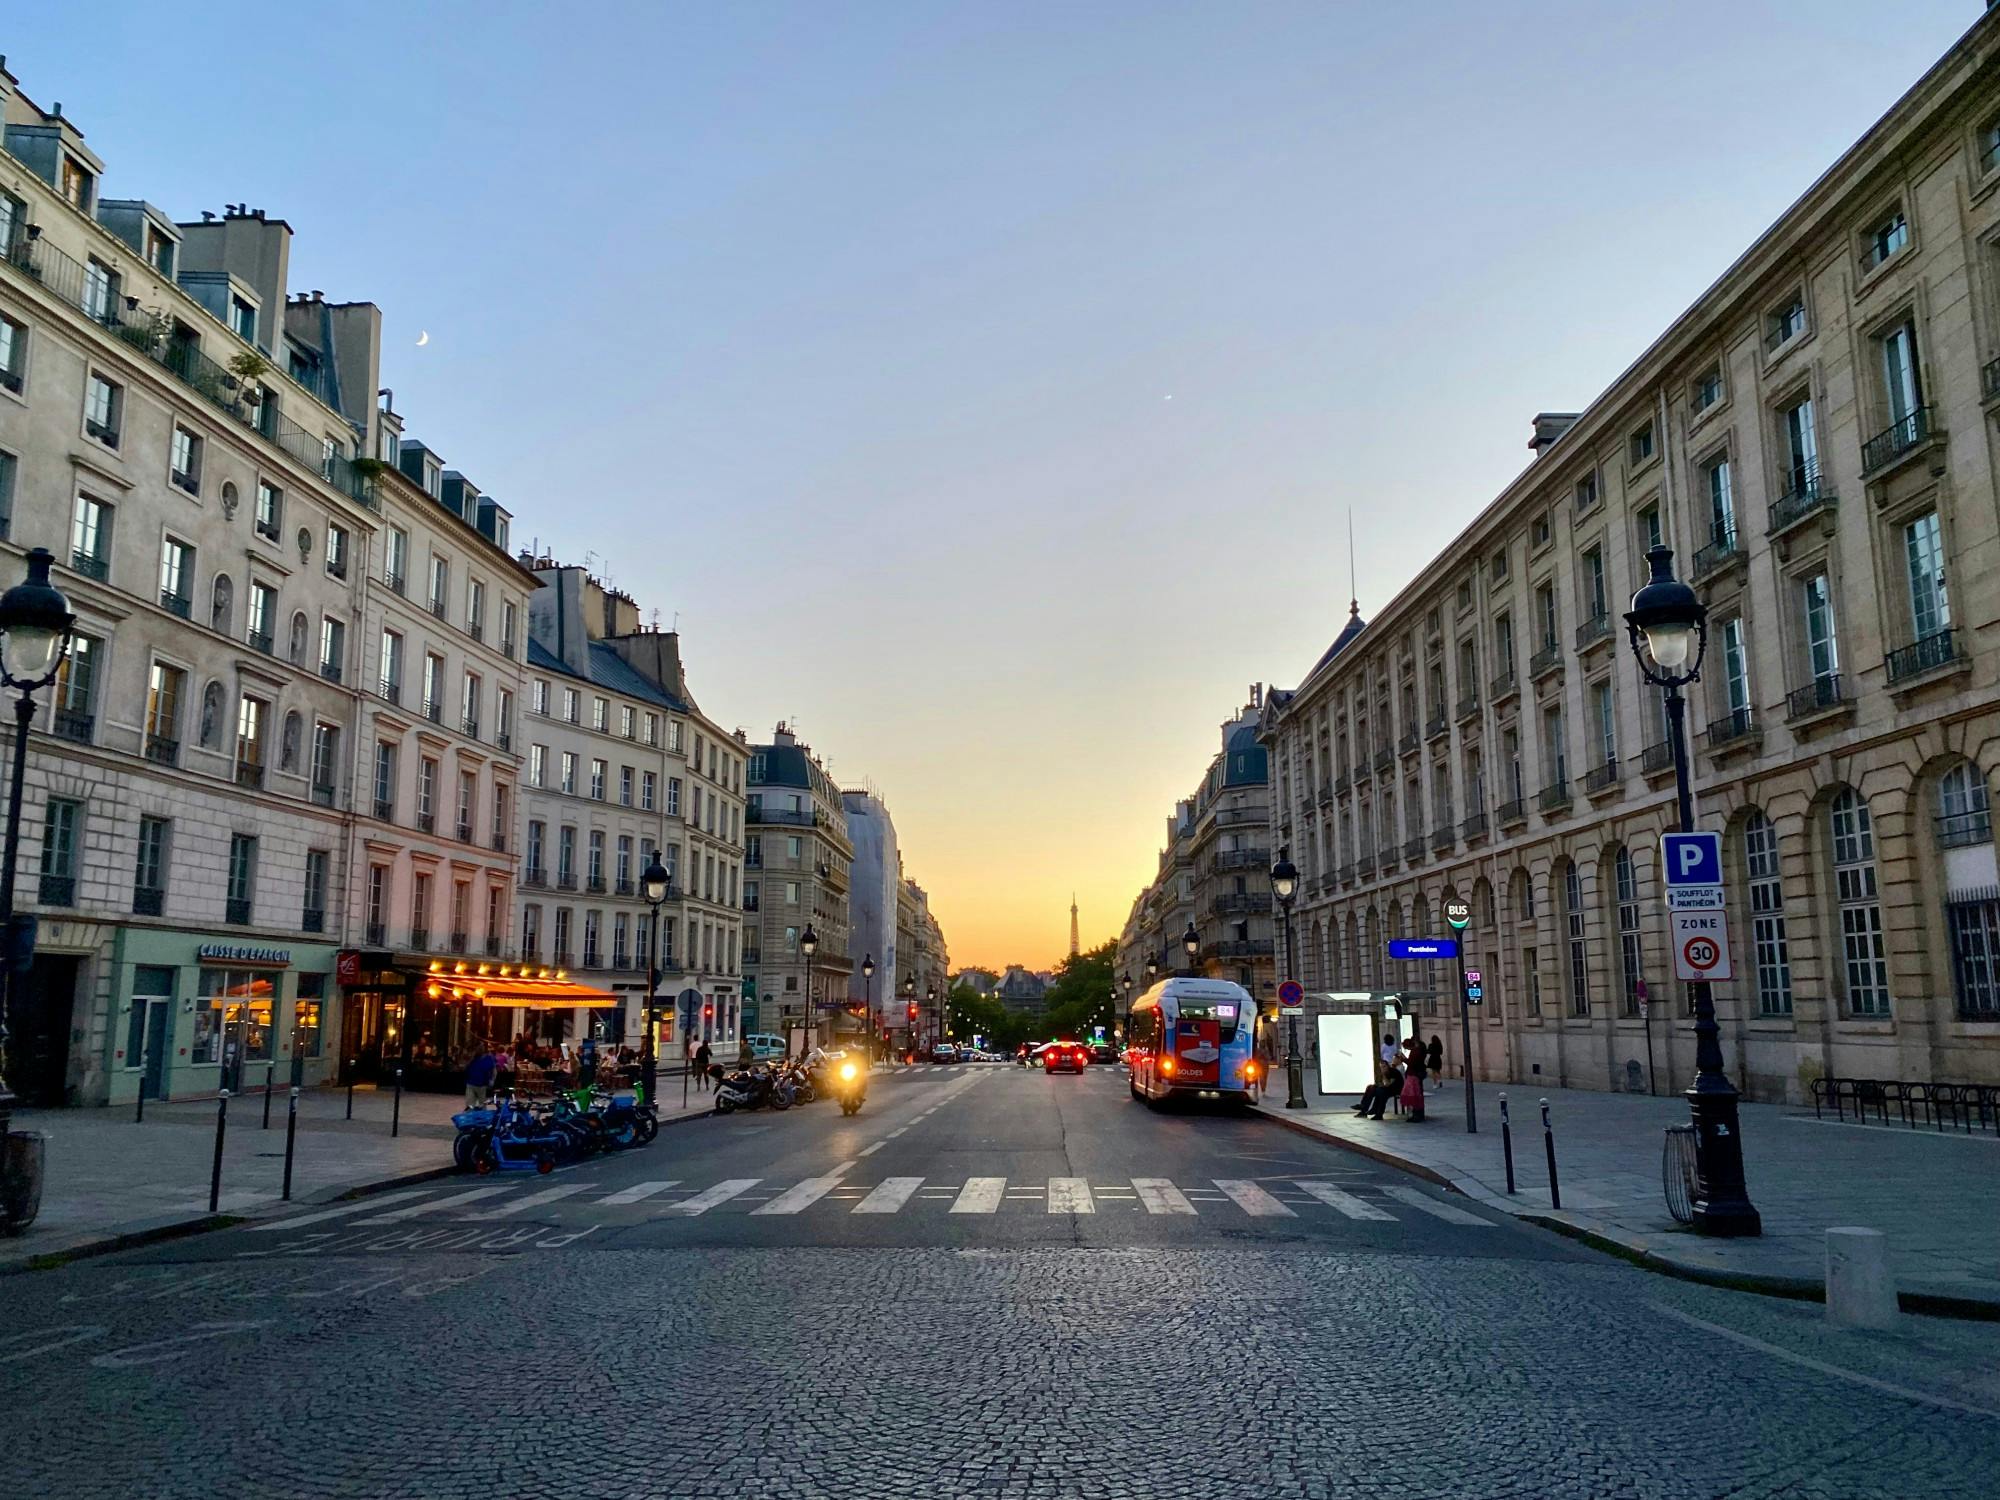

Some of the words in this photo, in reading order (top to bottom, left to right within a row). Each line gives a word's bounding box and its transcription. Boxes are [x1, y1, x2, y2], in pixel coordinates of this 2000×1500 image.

[1680, 844, 1703, 875] P
[1676, 889, 1714, 897] SOUFFLOT
[1448, 905, 1467, 915] BUS
[1681, 919, 1717, 929] ZONE
[200, 943, 238, 958] CAISSE
[1692, 946, 1713, 961] 30
[1177, 1068, 1204, 1077] SOLDES
